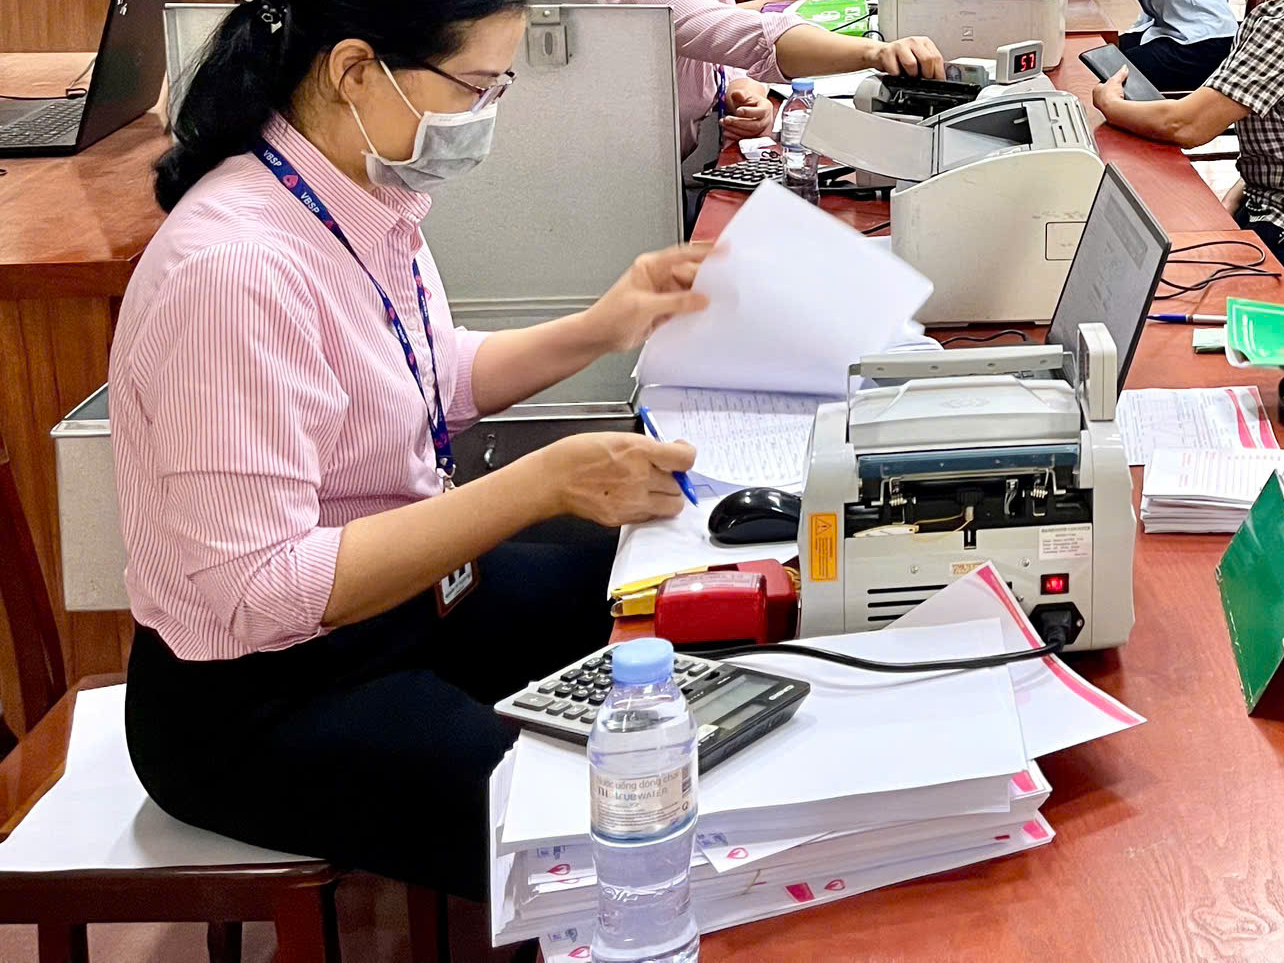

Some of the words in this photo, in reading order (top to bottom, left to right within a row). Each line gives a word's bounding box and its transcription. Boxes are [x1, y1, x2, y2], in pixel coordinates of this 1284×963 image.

[1020, 53, 1035, 72] 57
[263, 149, 283, 167] VBSP
[300, 191, 320, 214] VBSP
